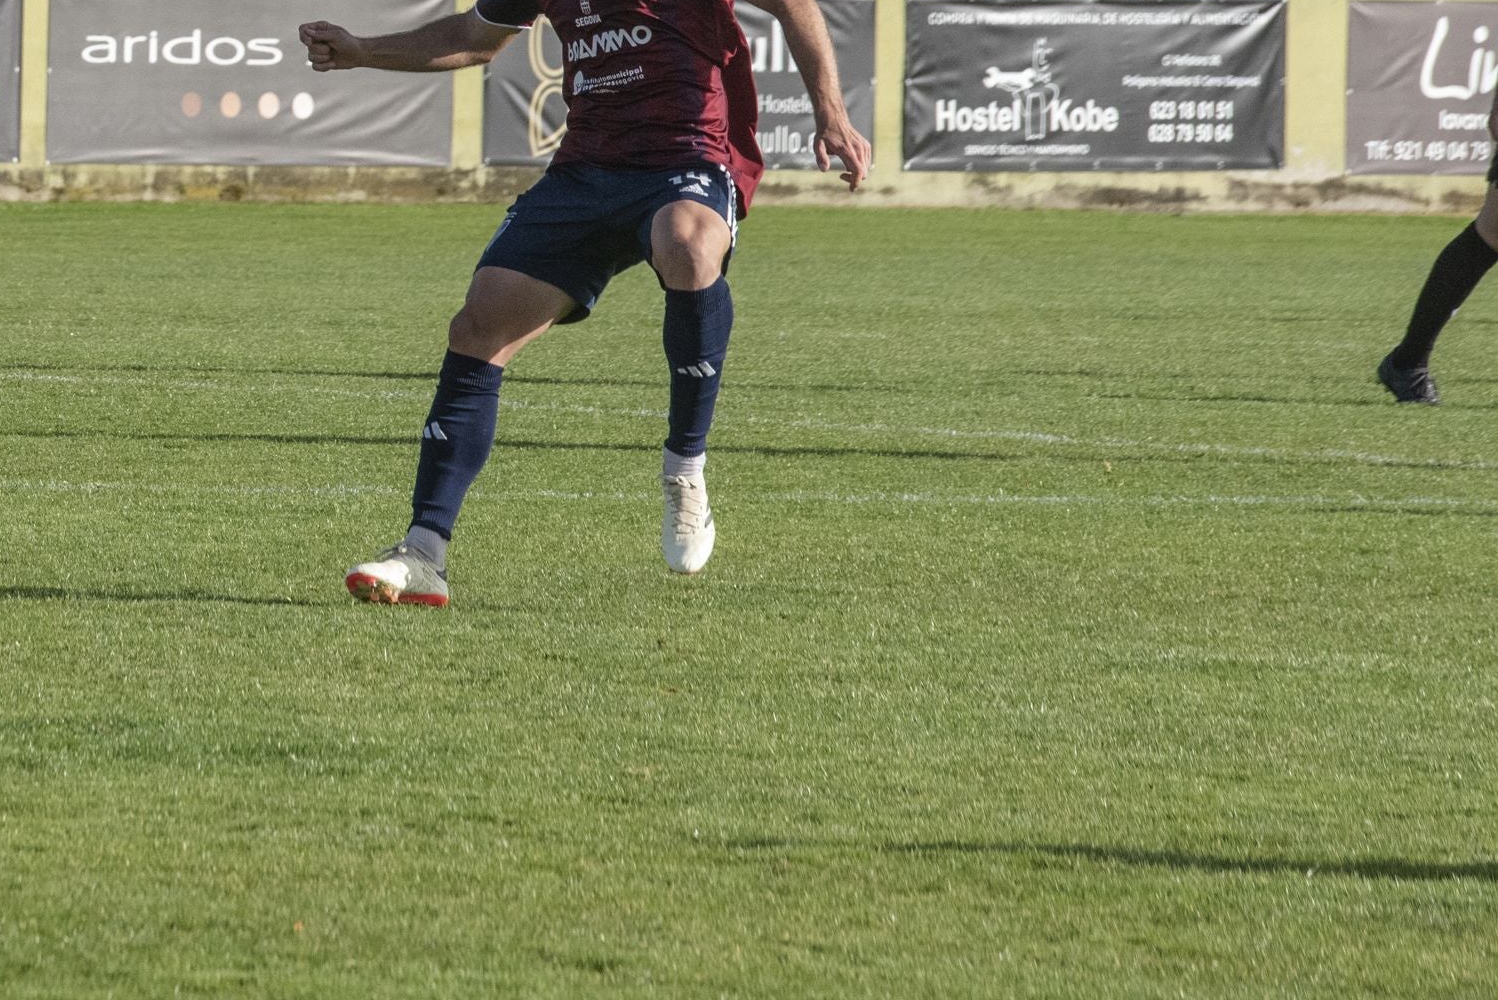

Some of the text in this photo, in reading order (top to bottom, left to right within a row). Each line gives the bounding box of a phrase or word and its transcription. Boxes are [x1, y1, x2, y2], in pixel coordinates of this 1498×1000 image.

[575, 14, 602, 28] SEGOVIA
[81, 29, 284, 66] aridos
[935, 99, 1119, 133] Hostel Kobe
[1215, 101, 1234, 119] 51
[1393, 141, 1422, 160] 921
[1425, 141, 1446, 160] 49
[1470, 141, 1491, 160] 79
